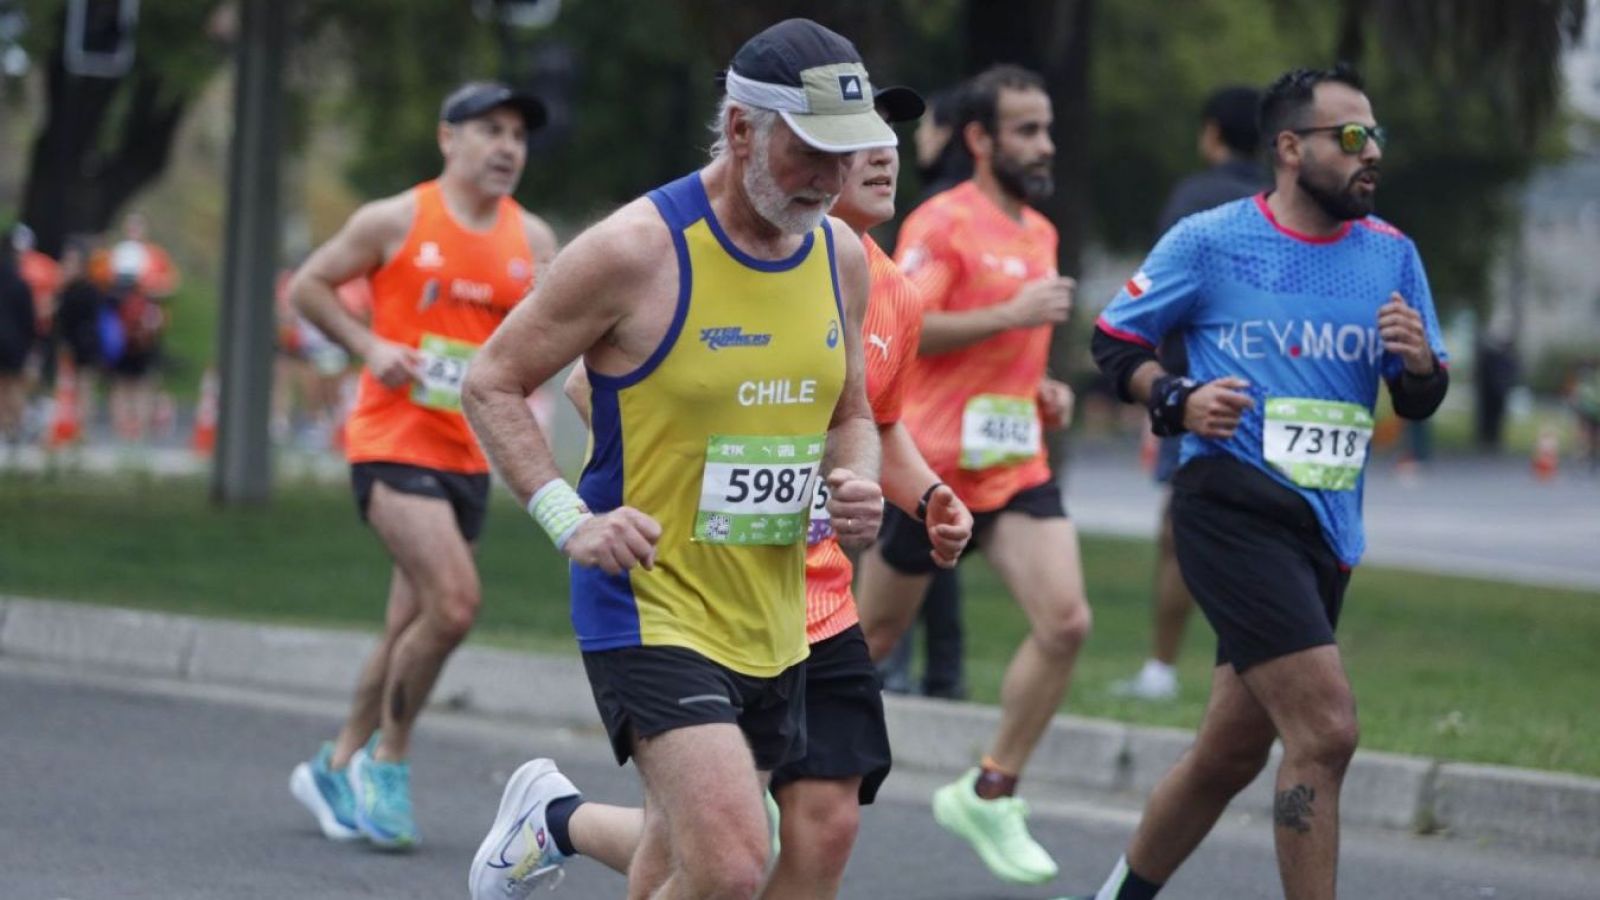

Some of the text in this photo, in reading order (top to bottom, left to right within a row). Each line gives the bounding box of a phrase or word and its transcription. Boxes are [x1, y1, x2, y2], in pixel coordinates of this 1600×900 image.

[738, 379, 817, 406] CHILE
[1284, 425, 1358, 457] 7318
[725, 467, 813, 503] 5987
